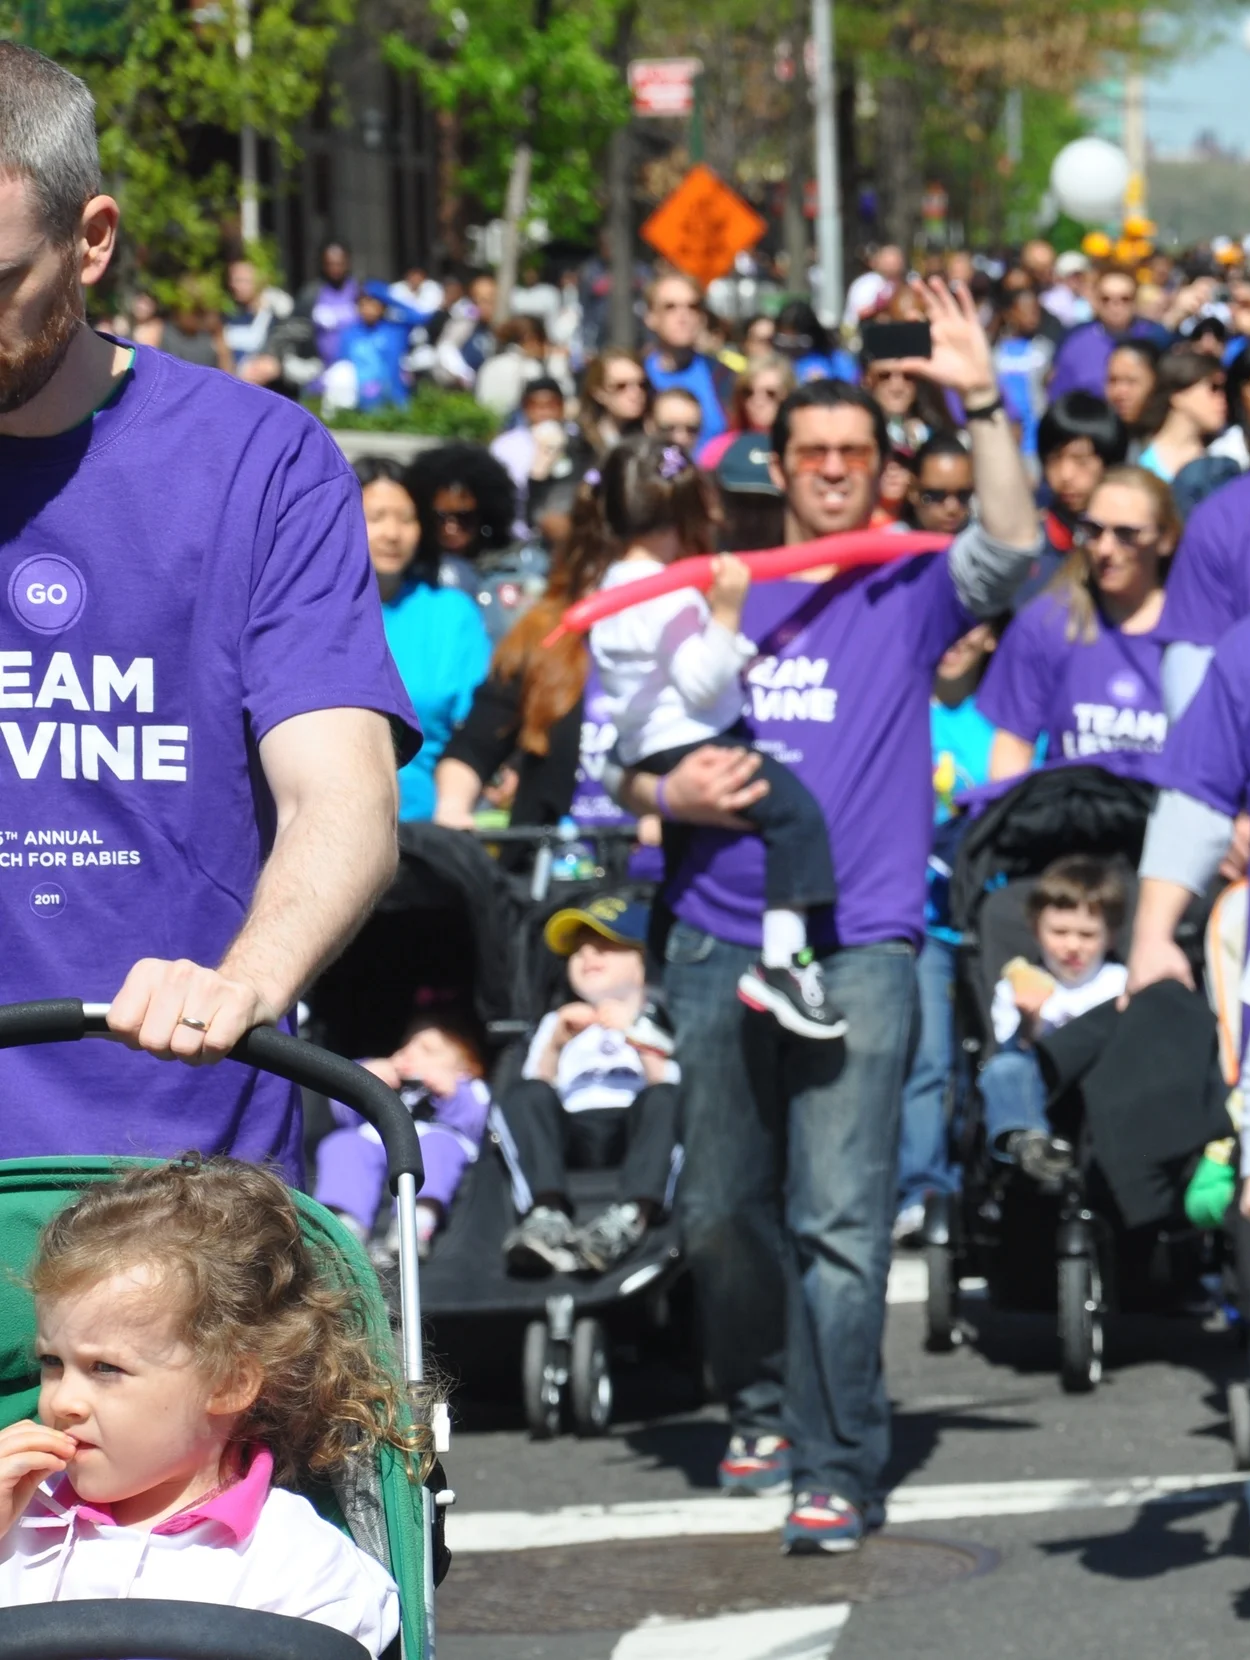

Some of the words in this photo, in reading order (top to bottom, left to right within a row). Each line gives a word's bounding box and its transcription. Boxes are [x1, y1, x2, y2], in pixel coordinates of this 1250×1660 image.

[26, 582, 68, 605] GO
[741, 685, 838, 722] VINE
[1072, 702, 1168, 744] TEAM
[24, 830, 104, 845] ANNUAL
[28, 852, 67, 867] FOR
[72, 850, 141, 866] BABIES
[34, 894, 60, 905] 2011
